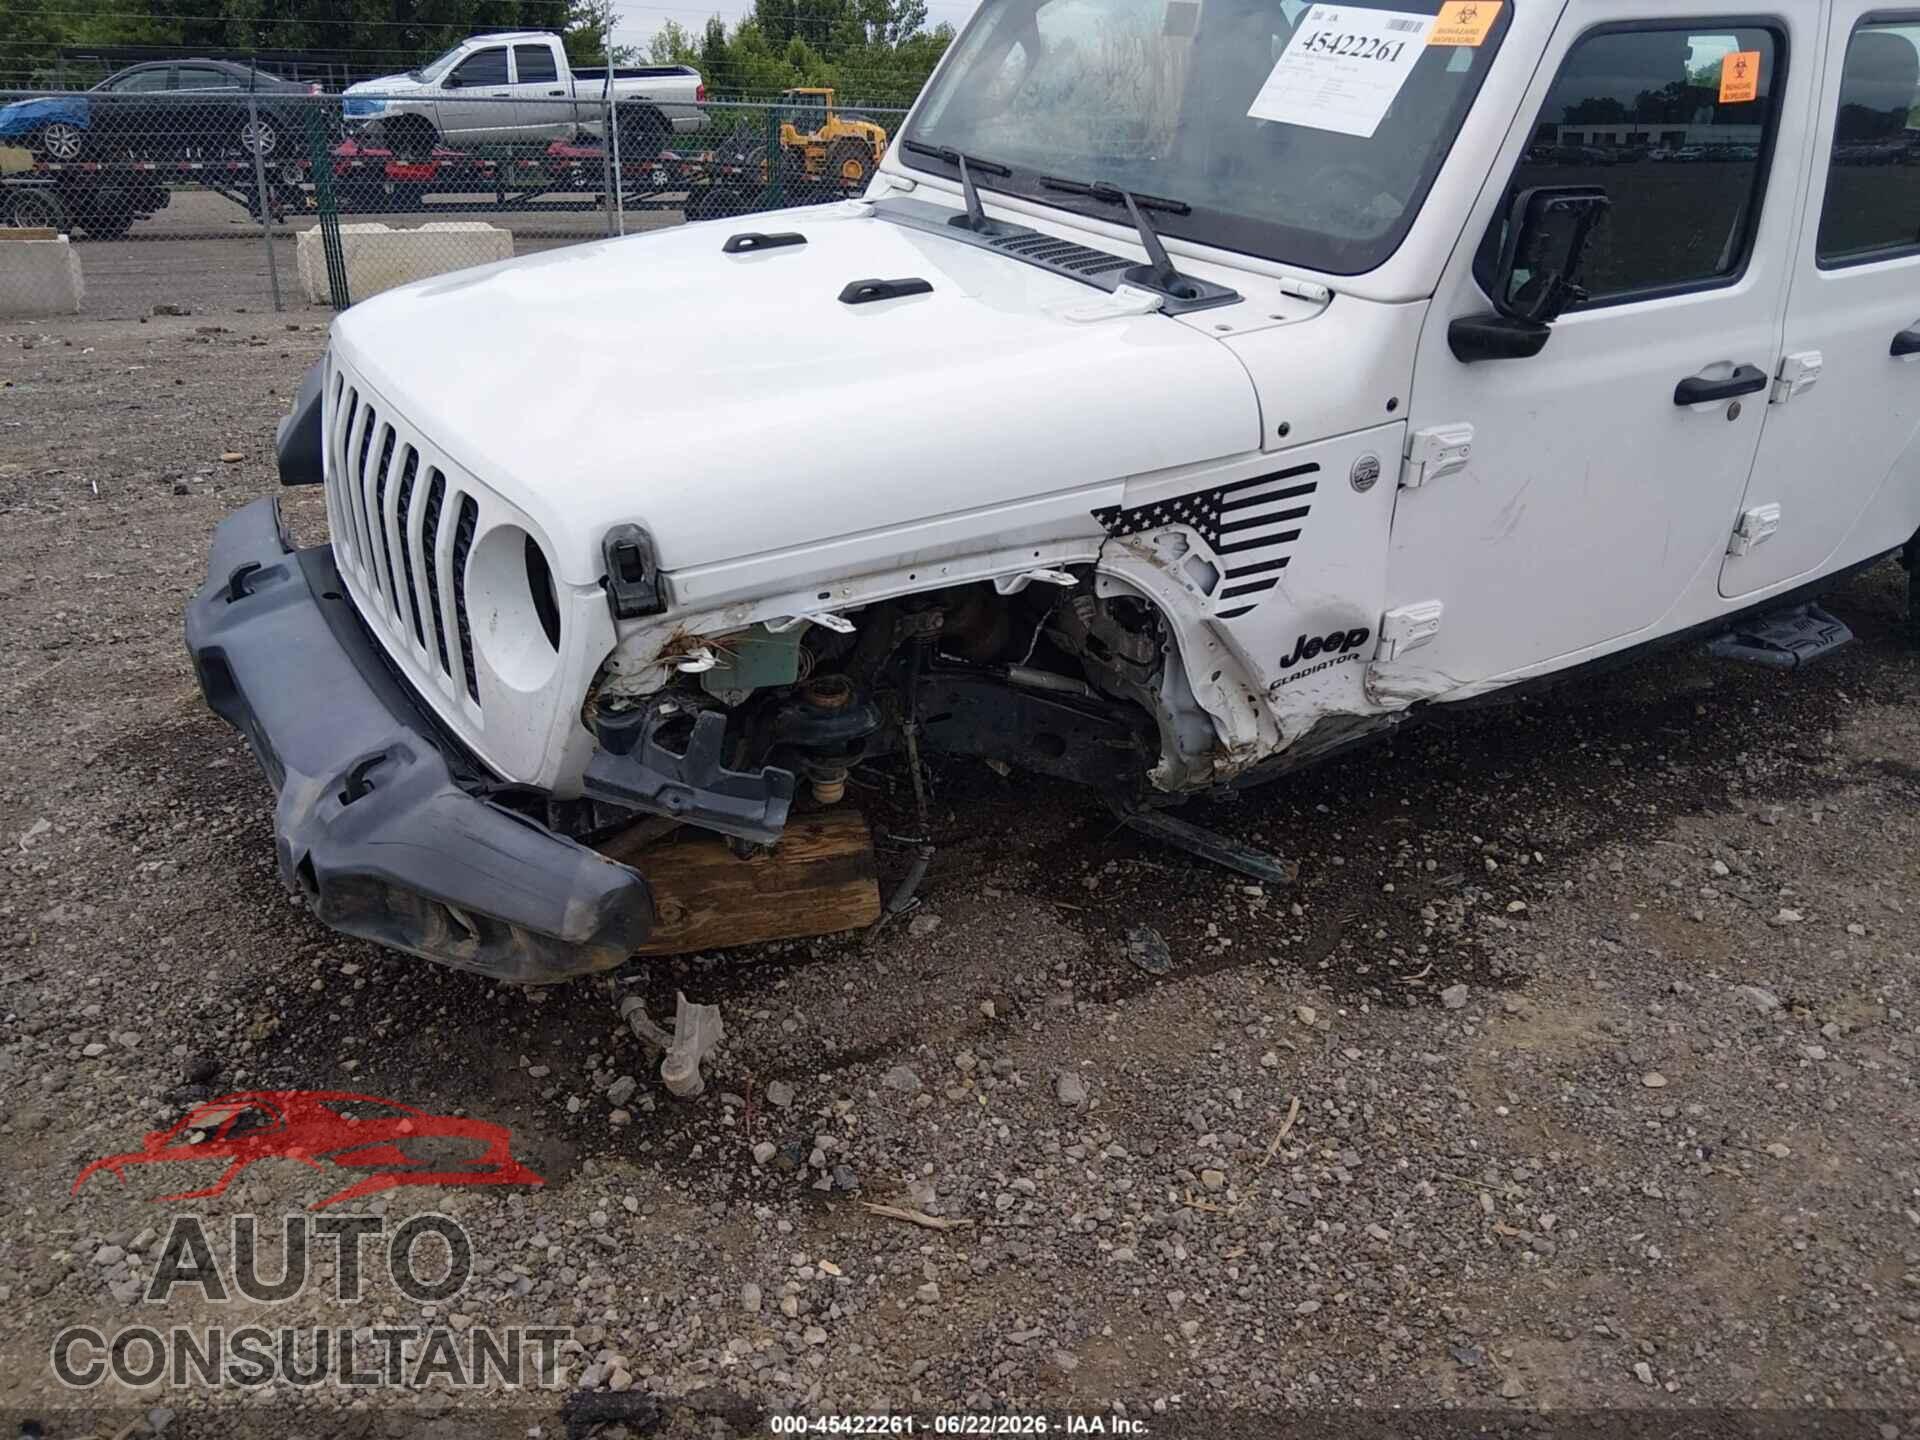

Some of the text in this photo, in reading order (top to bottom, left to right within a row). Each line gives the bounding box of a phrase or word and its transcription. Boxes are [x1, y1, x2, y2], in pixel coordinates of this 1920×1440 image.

[1302, 31, 1405, 61] 45422261
[1280, 628, 1370, 669] Jeep
[1269, 653, 1360, 690] GLADIATOR
